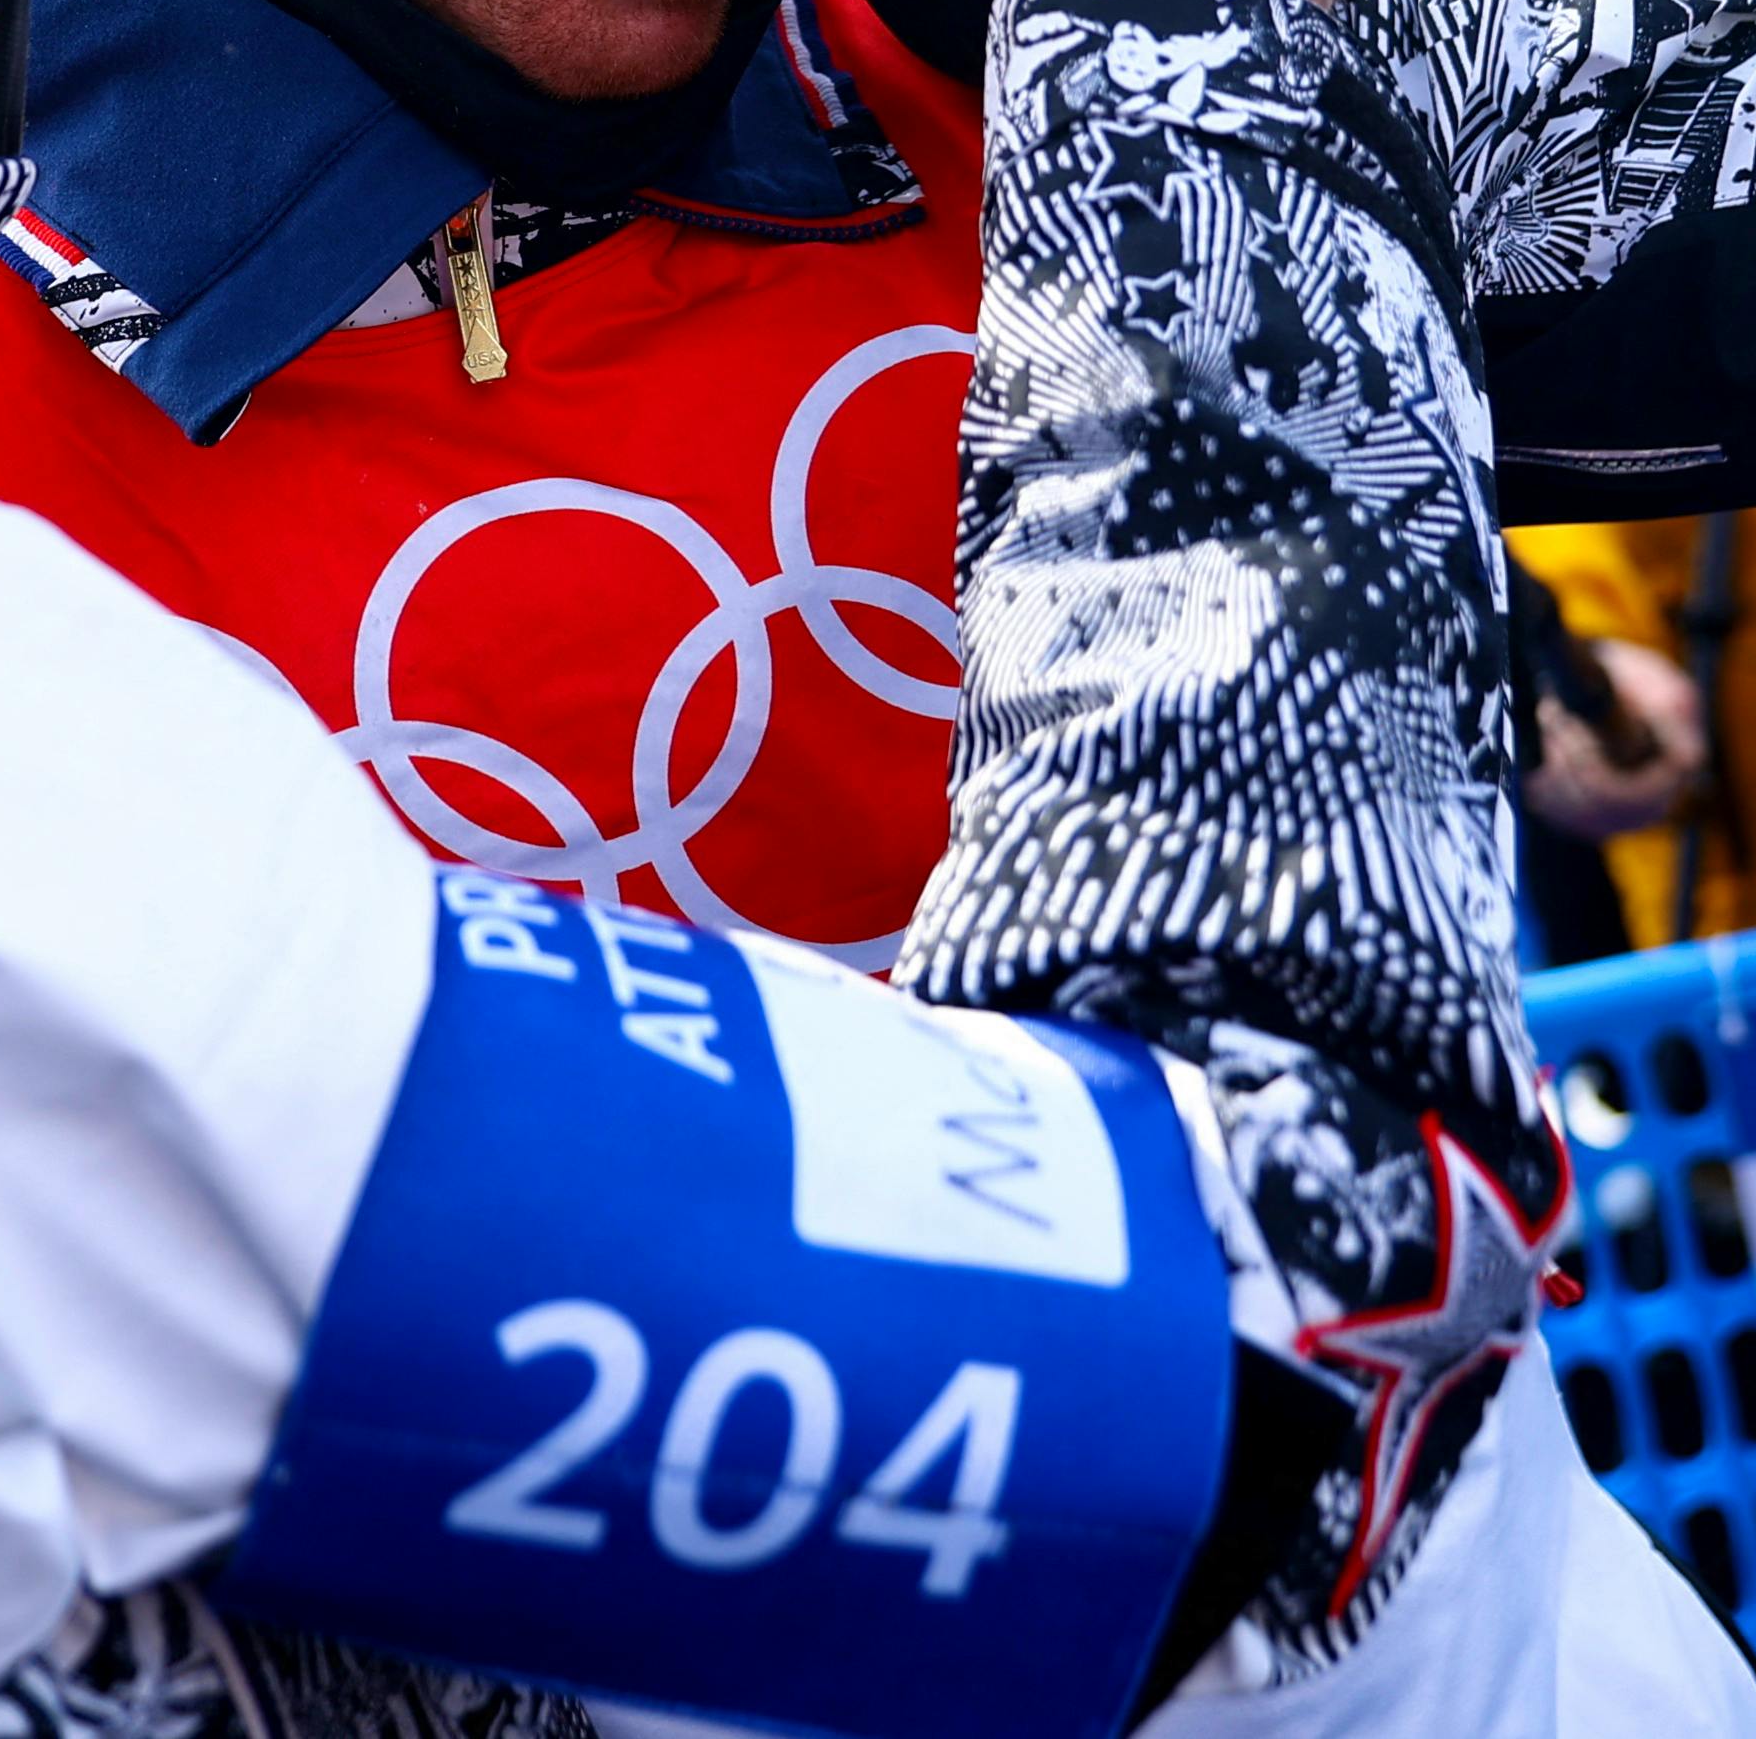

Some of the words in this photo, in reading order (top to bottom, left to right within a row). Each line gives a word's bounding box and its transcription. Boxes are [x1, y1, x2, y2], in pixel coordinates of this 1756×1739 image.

[466, 350, 501, 369] USA
[582, 900, 737, 1086] ATT
[444, 1296, 1022, 1599] 204
